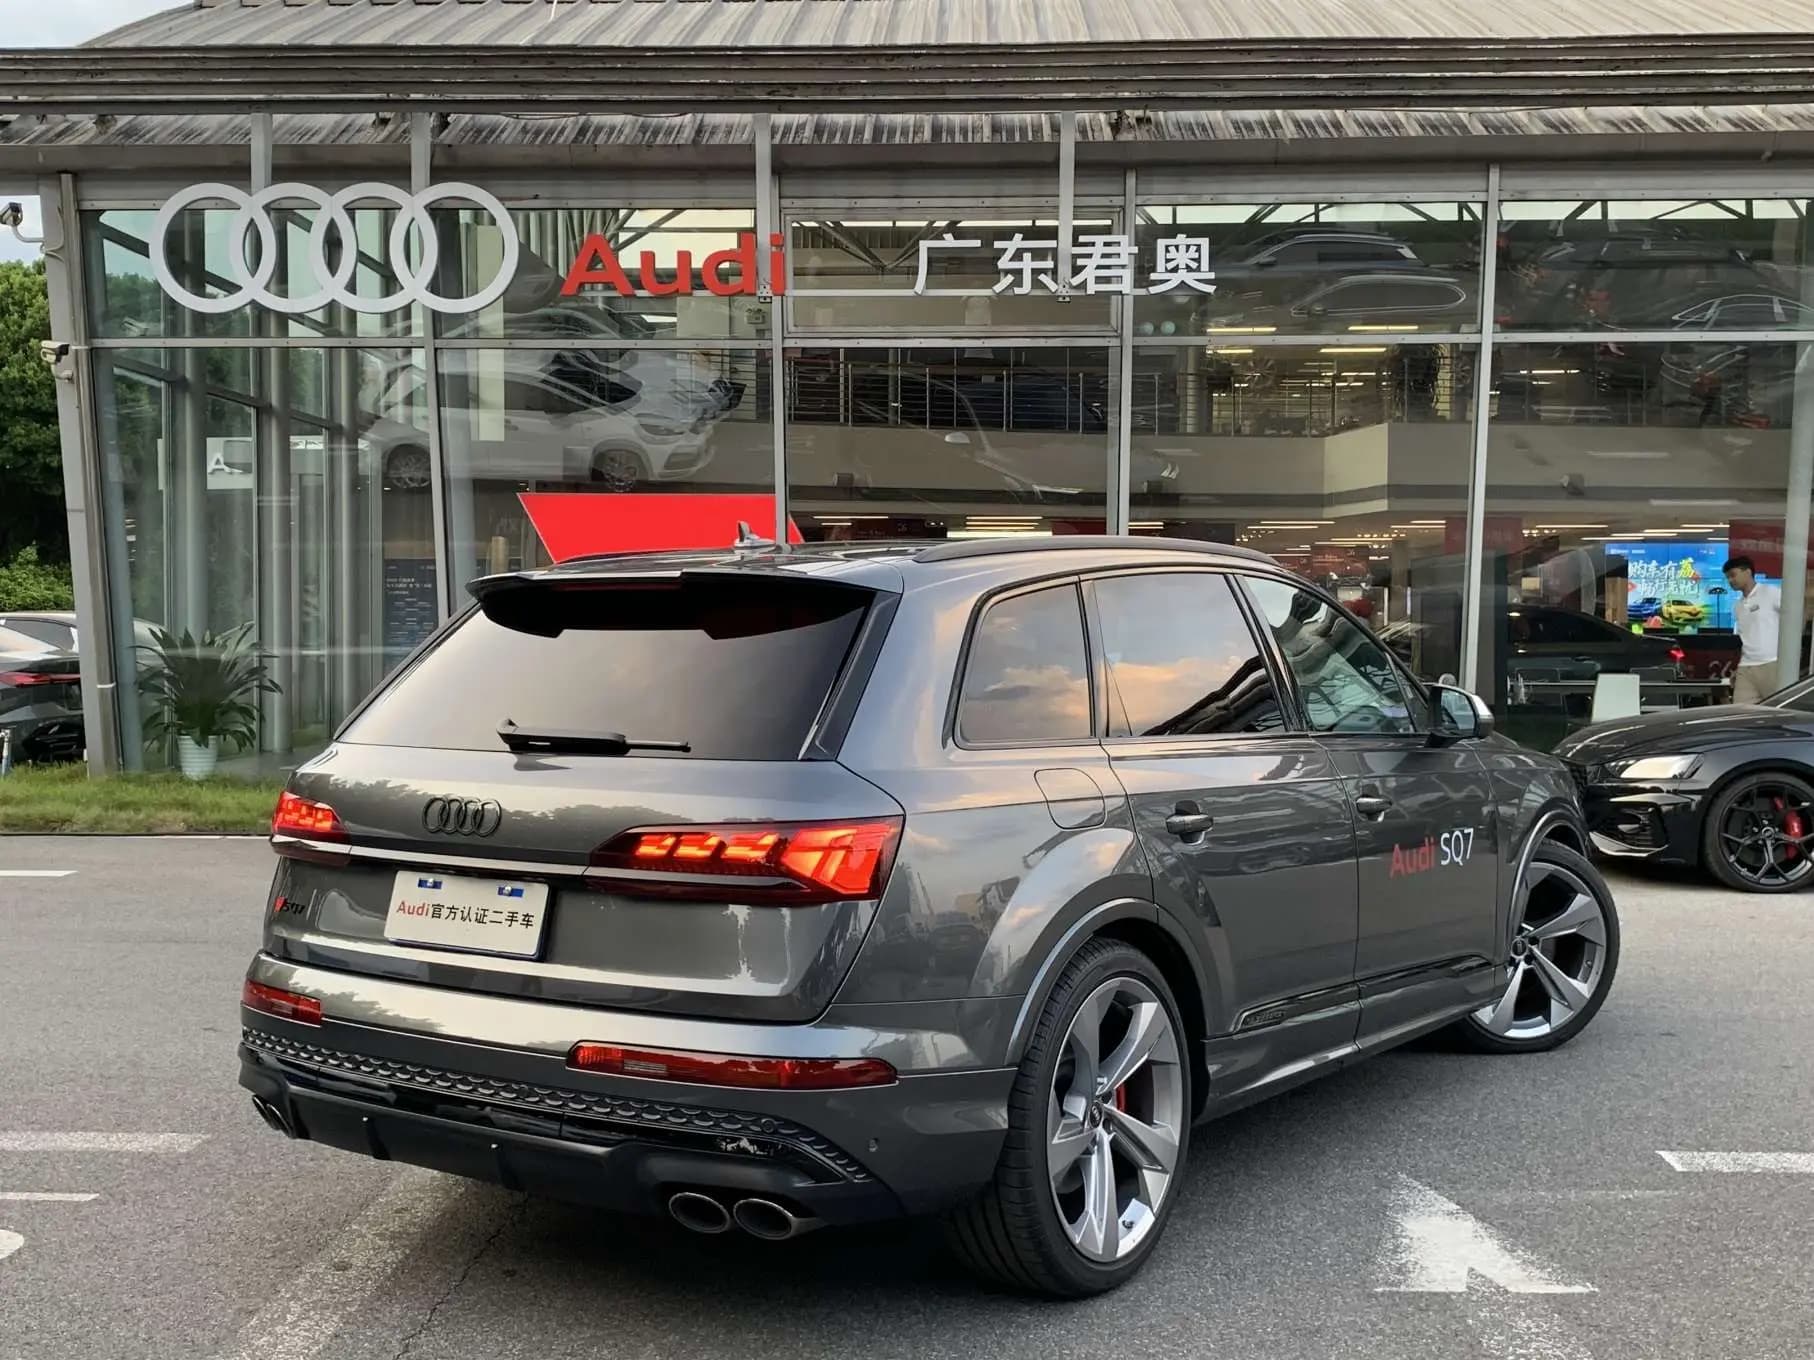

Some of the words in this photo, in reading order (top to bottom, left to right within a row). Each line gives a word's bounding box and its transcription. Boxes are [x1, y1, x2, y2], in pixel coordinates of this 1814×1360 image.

[560, 232, 786, 296] Audi
[914, 233, 1217, 296] 广东君奥
[1389, 836, 1436, 879] Audi
[1440, 827, 1474, 866] SQ7
